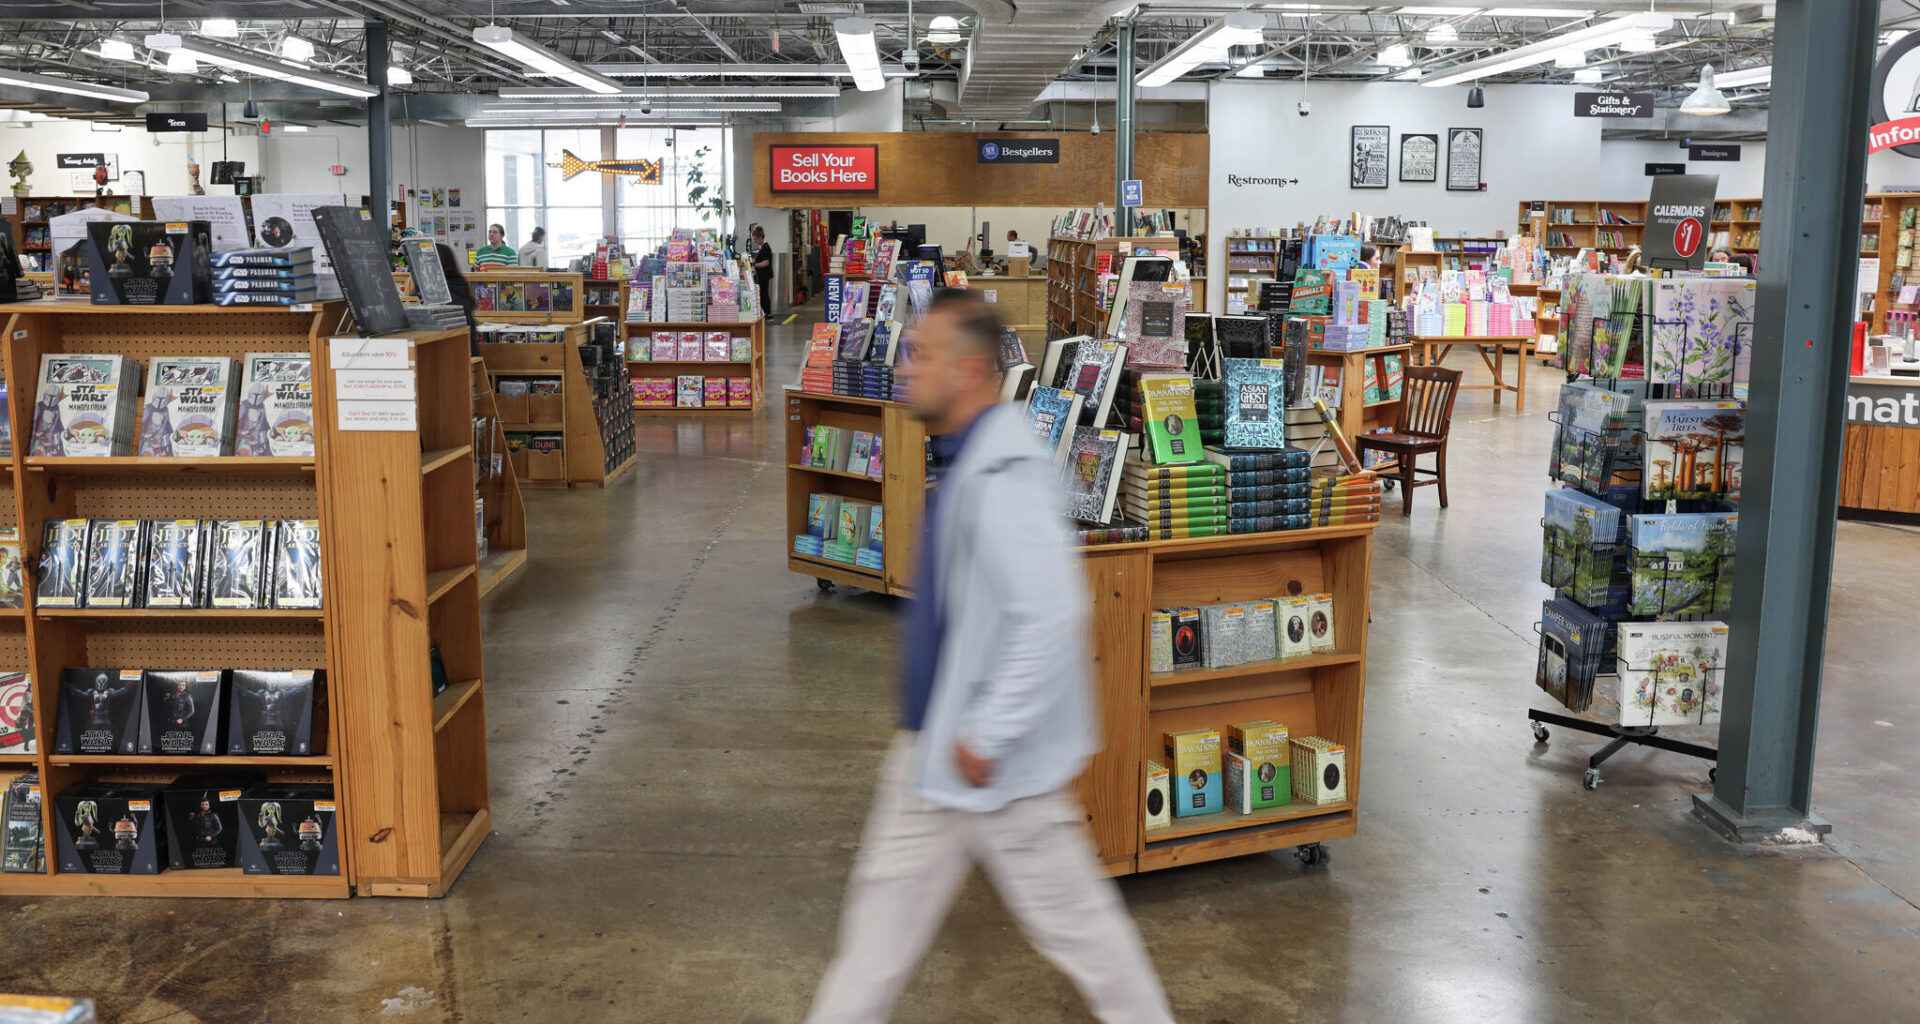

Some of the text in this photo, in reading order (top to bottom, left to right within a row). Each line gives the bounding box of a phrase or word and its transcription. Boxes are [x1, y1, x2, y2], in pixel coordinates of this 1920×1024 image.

[1598, 96, 1630, 105] Gifts &
[1590, 105, 1642, 115] Stationery
[168, 119, 186, 127] Teen
[1869, 126, 1920, 148] Infor
[1002, 147, 1053, 158] Bestsellers
[64, 156, 82, 165] Young
[792, 153, 855, 167] Sell Your
[781, 169, 867, 183] Books Here
[1228, 174, 1288, 188] Restrooms
[1654, 205, 1705, 217] CALENDARS
[1681, 222, 1694, 253] $1
[246, 256, 273, 264] PADAWAN
[250, 268, 277, 276] PADAWAN
[251, 280, 278, 288] PADAWAN
[828, 277, 840, 301] NEW
[1294, 286, 1324, 298] ANIMALS
[252, 294, 279, 302] PADAWAN
[1241, 385, 1267, 393] ASIAN
[71, 394, 108, 402] WARS
[180, 396, 216, 404] WARS
[275, 392, 312, 400] WARS
[1240, 392, 1267, 404] GHOST
[1665, 415, 1704, 424] MAJESTY
[535, 441, 556, 449] DUNE
[1660, 518, 1726, 533] Fields of Home
[48, 527, 82, 542] JEDI
[1544, 606, 1581, 636] CAMPER VANS
[81, 730, 113, 739] STAR
[161, 731, 193, 739] STAR
[253, 730, 285, 739] STAR
[81, 738, 113, 746] WARS
[161, 739, 193, 747] WARS
[253, 738, 285, 747] WARS
